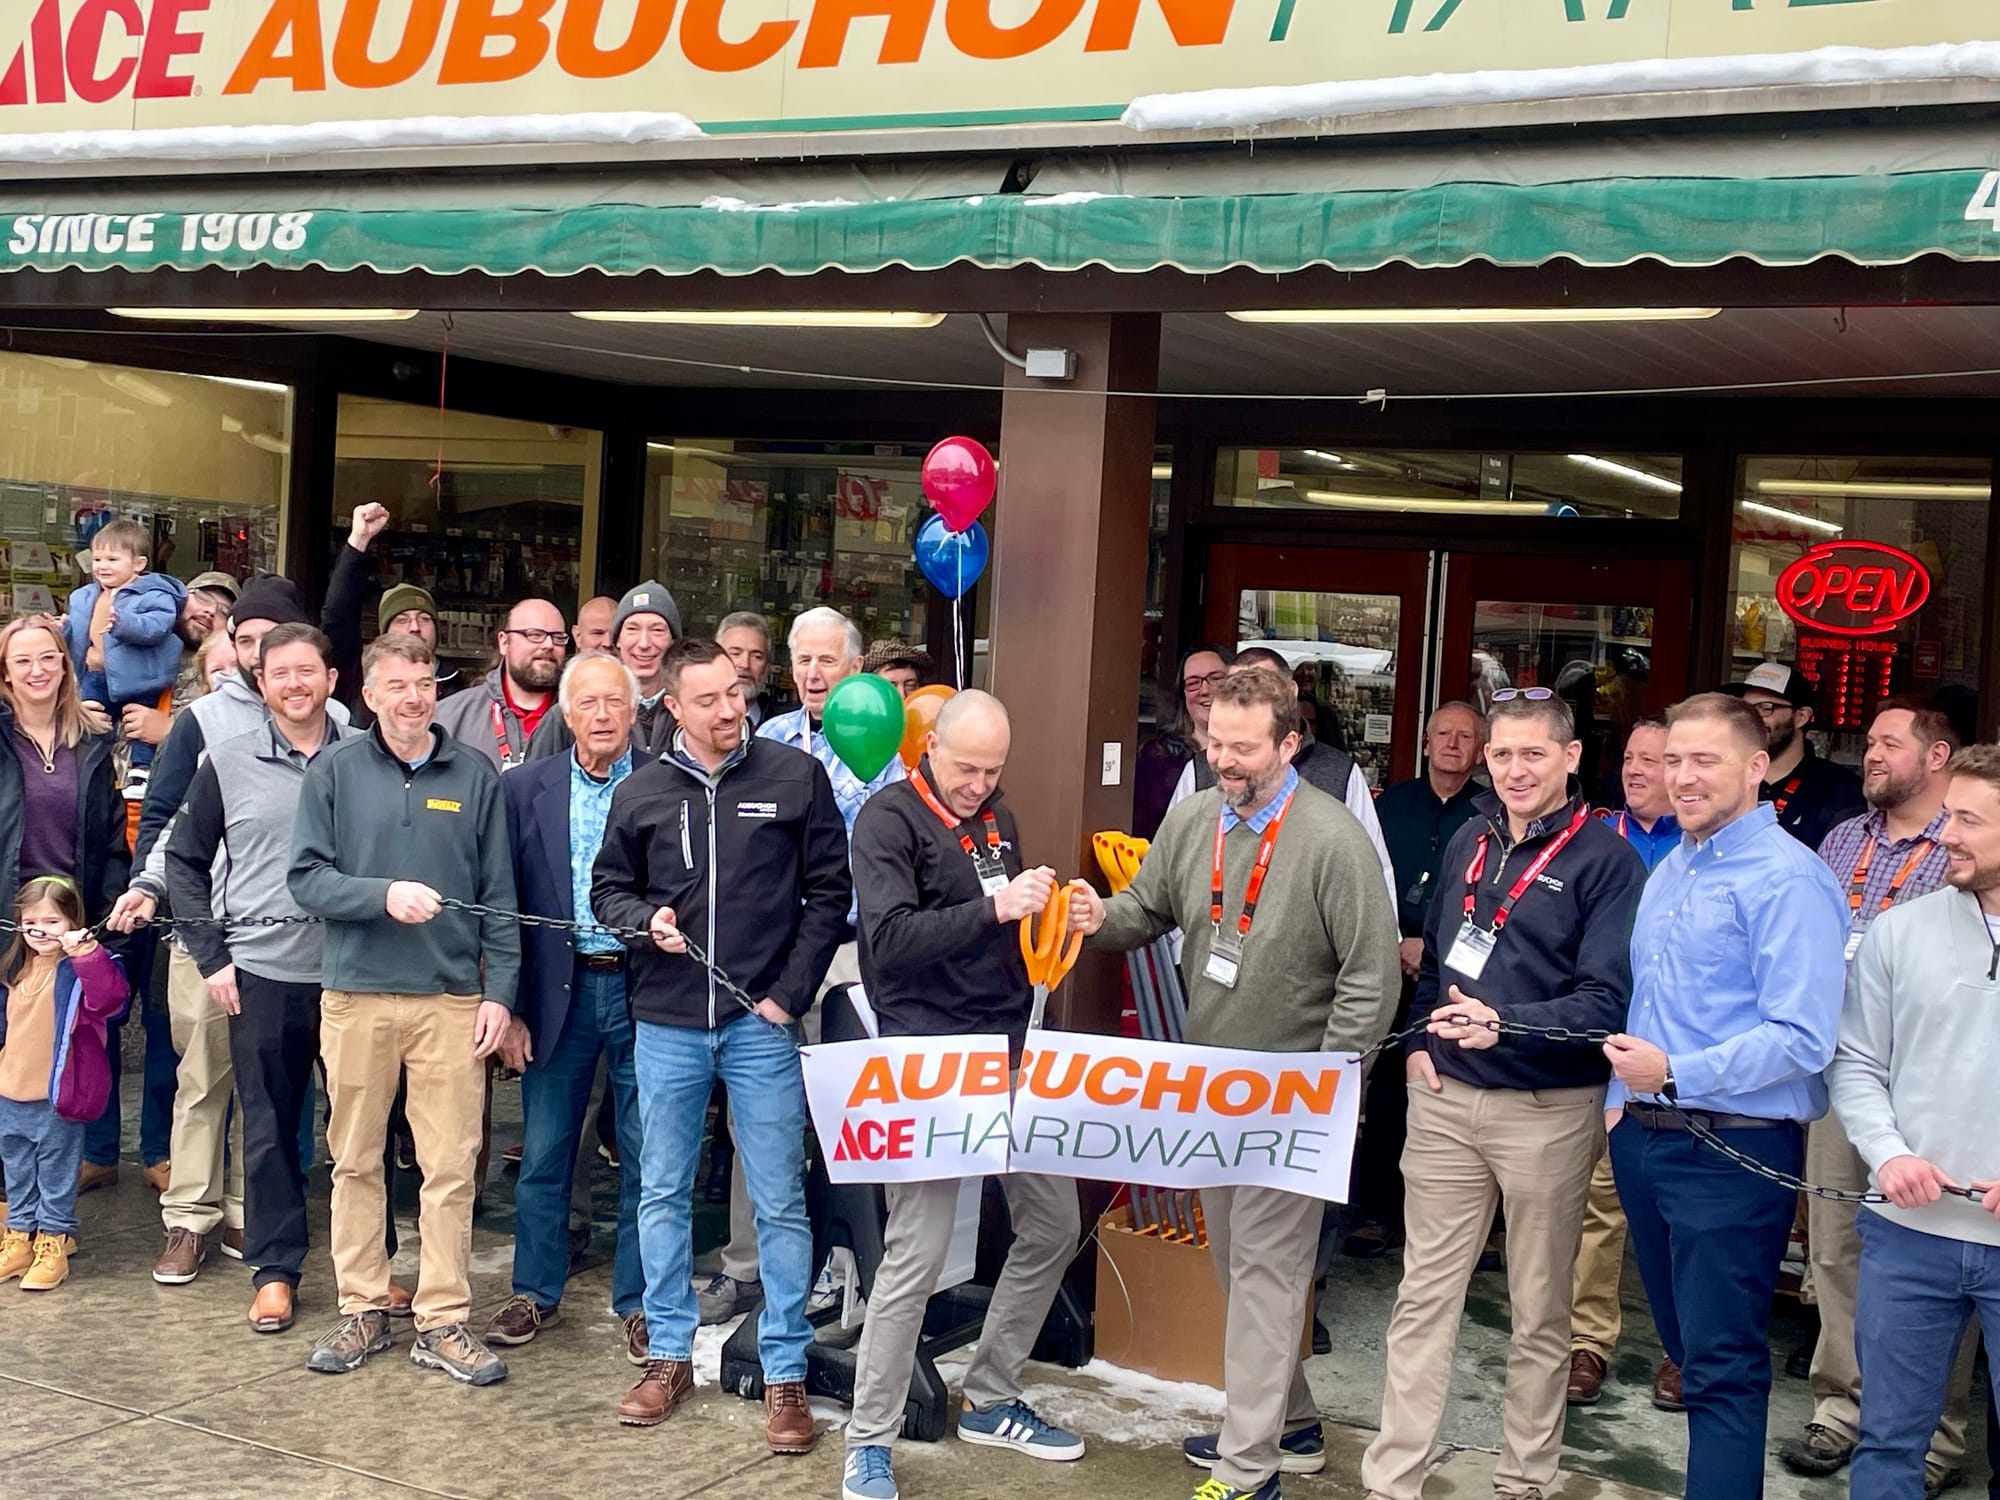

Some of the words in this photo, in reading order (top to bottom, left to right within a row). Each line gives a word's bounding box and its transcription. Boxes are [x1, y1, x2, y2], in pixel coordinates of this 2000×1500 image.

[0, 0, 211, 105] ACE
[8, 212, 165, 254] SINCE
[180, 211, 314, 252] 1908
[1784, 564, 1916, 612] OPEN
[1800, 637, 1852, 650] BUSINESS
[1855, 640, 1898, 653] HOURS
[1537, 873, 1564, 888] BUCHON
[845, 1048, 1341, 1117] AUBUCHON
[833, 1116, 916, 1162] ACE
[925, 1110, 1330, 1174] HARDWARE
